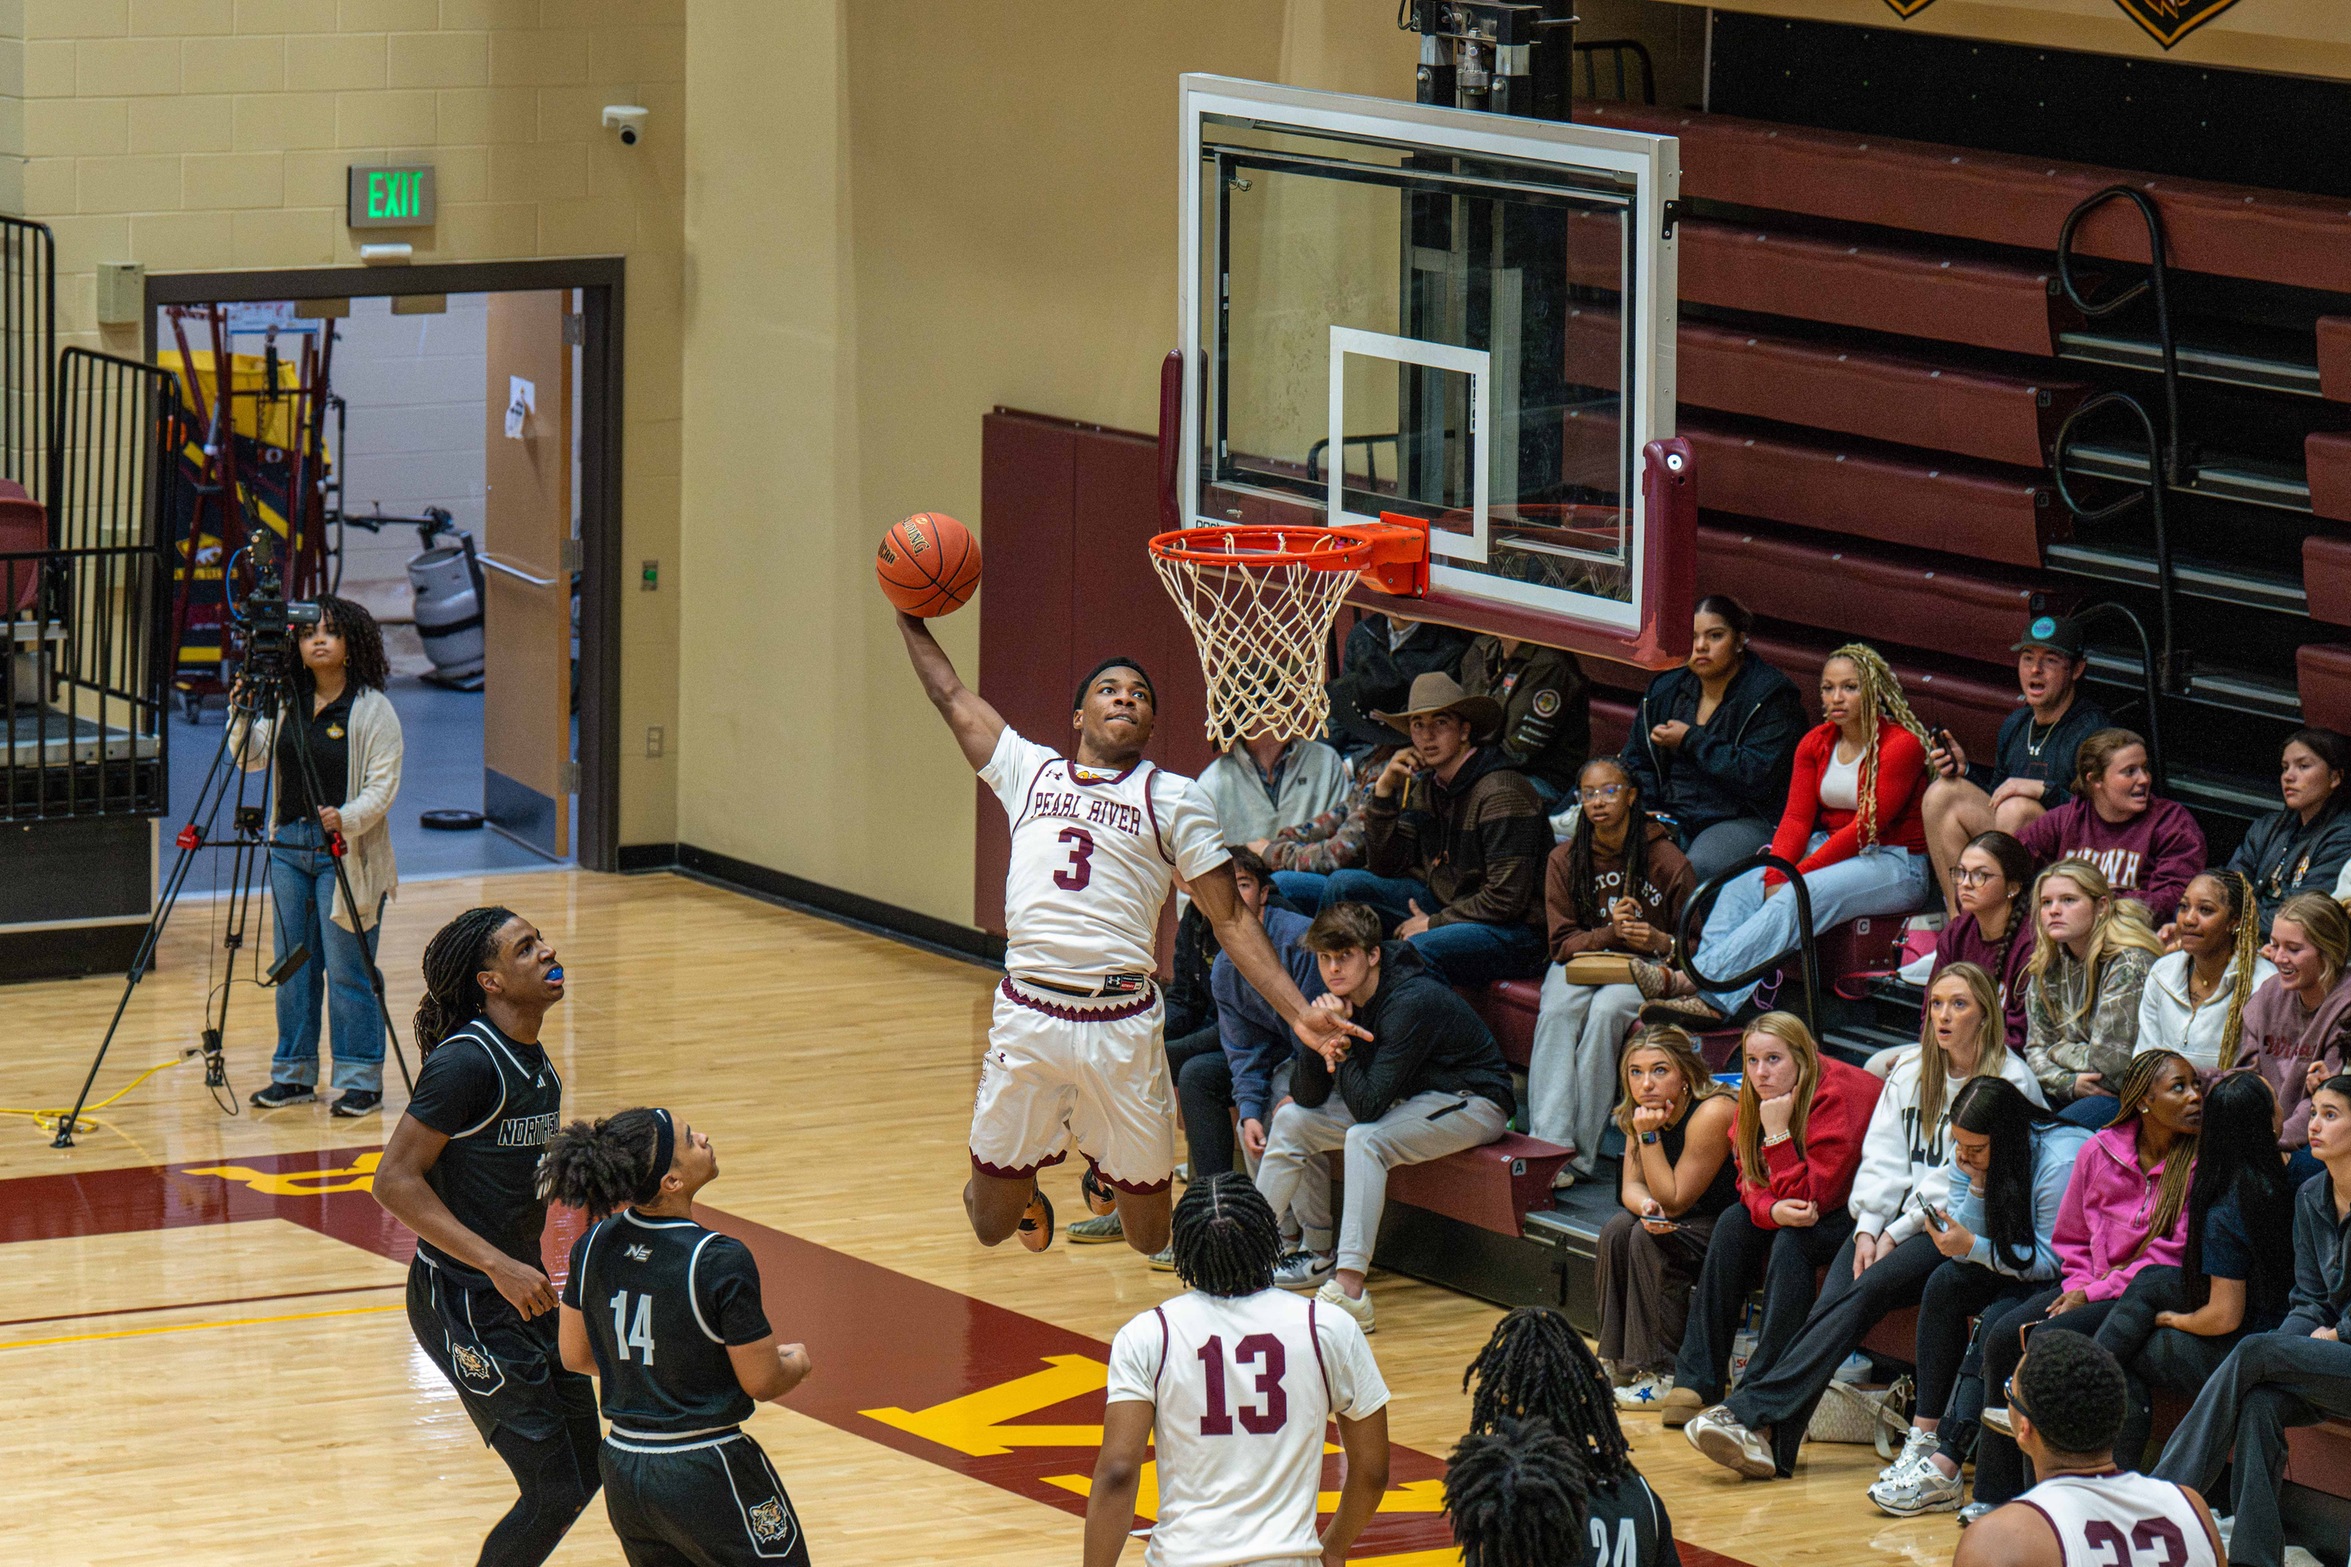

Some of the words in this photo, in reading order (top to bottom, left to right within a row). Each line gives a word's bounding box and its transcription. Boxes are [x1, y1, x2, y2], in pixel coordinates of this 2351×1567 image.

[368, 171, 423, 218] EXIT
[1030, 792, 1081, 819] PEARL
[1086, 800, 1141, 836] RIVER
[1053, 826, 1094, 892] 3
[623, 1243, 653, 1262] NE
[609, 1289, 655, 1366] 14
[1197, 1333, 1287, 1436] 13
